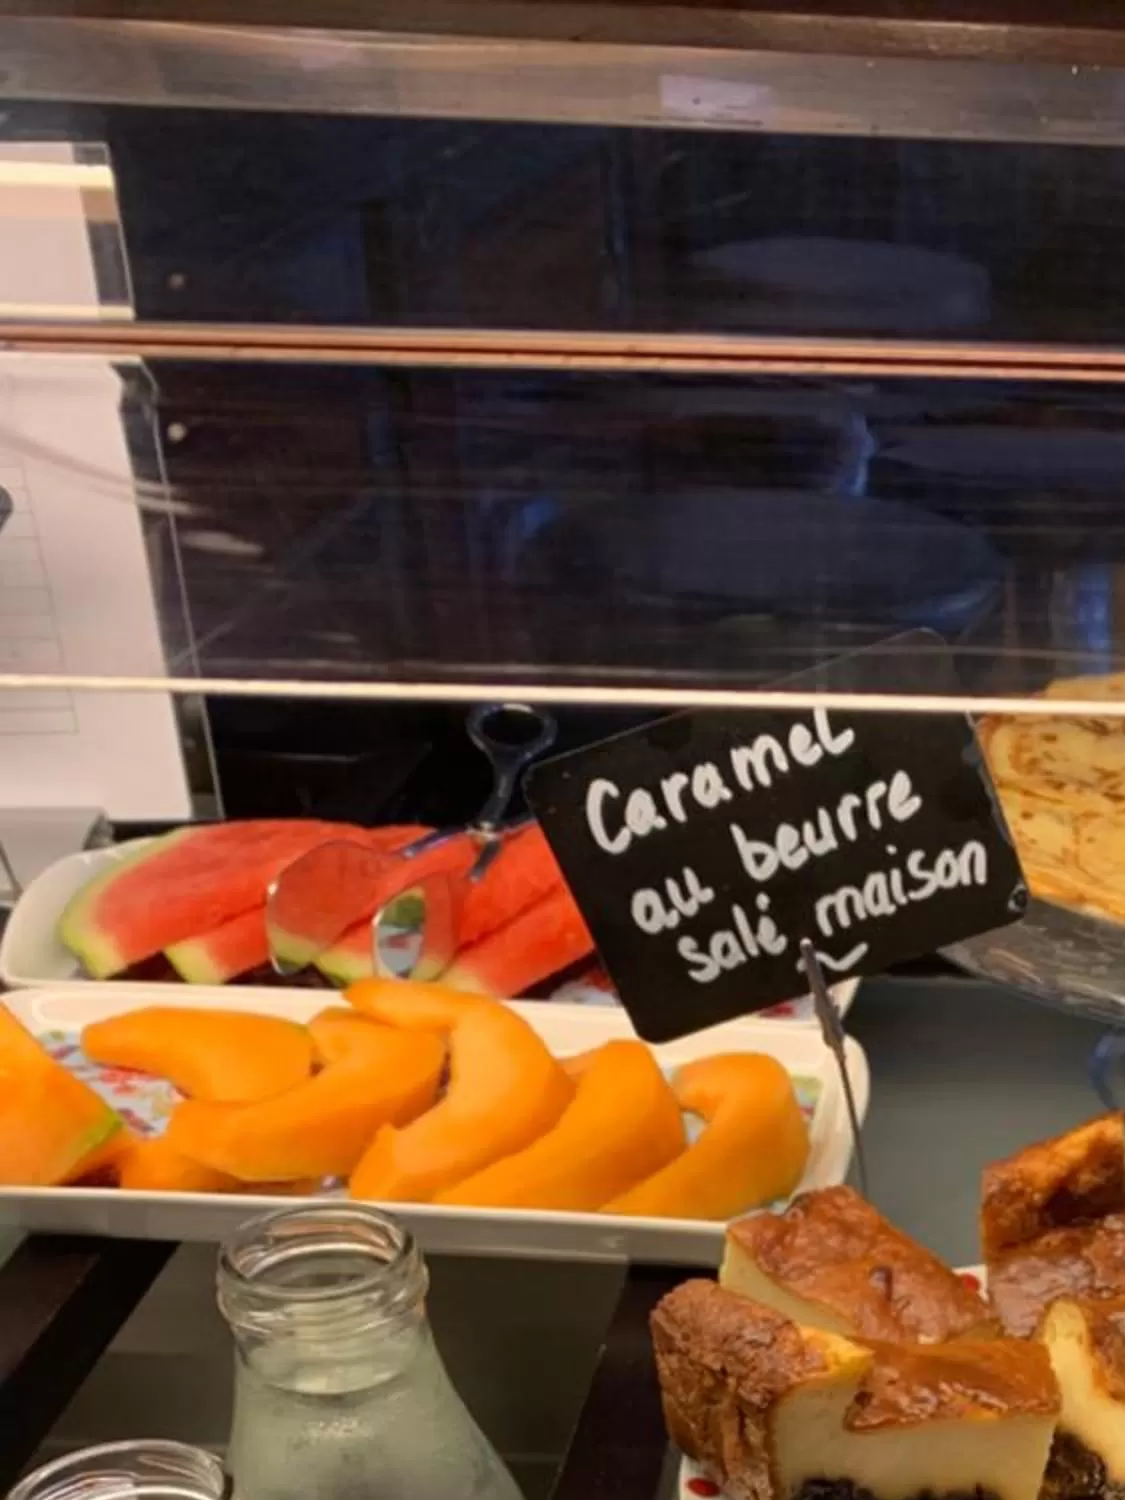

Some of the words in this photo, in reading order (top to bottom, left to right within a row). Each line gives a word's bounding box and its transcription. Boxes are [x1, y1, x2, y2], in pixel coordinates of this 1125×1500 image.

[586, 704, 854, 854] Caramel
[631, 866, 714, 934] au
[732, 770, 922, 881] beurre
[677, 893, 788, 983] salé
[815, 839, 987, 936] maison
